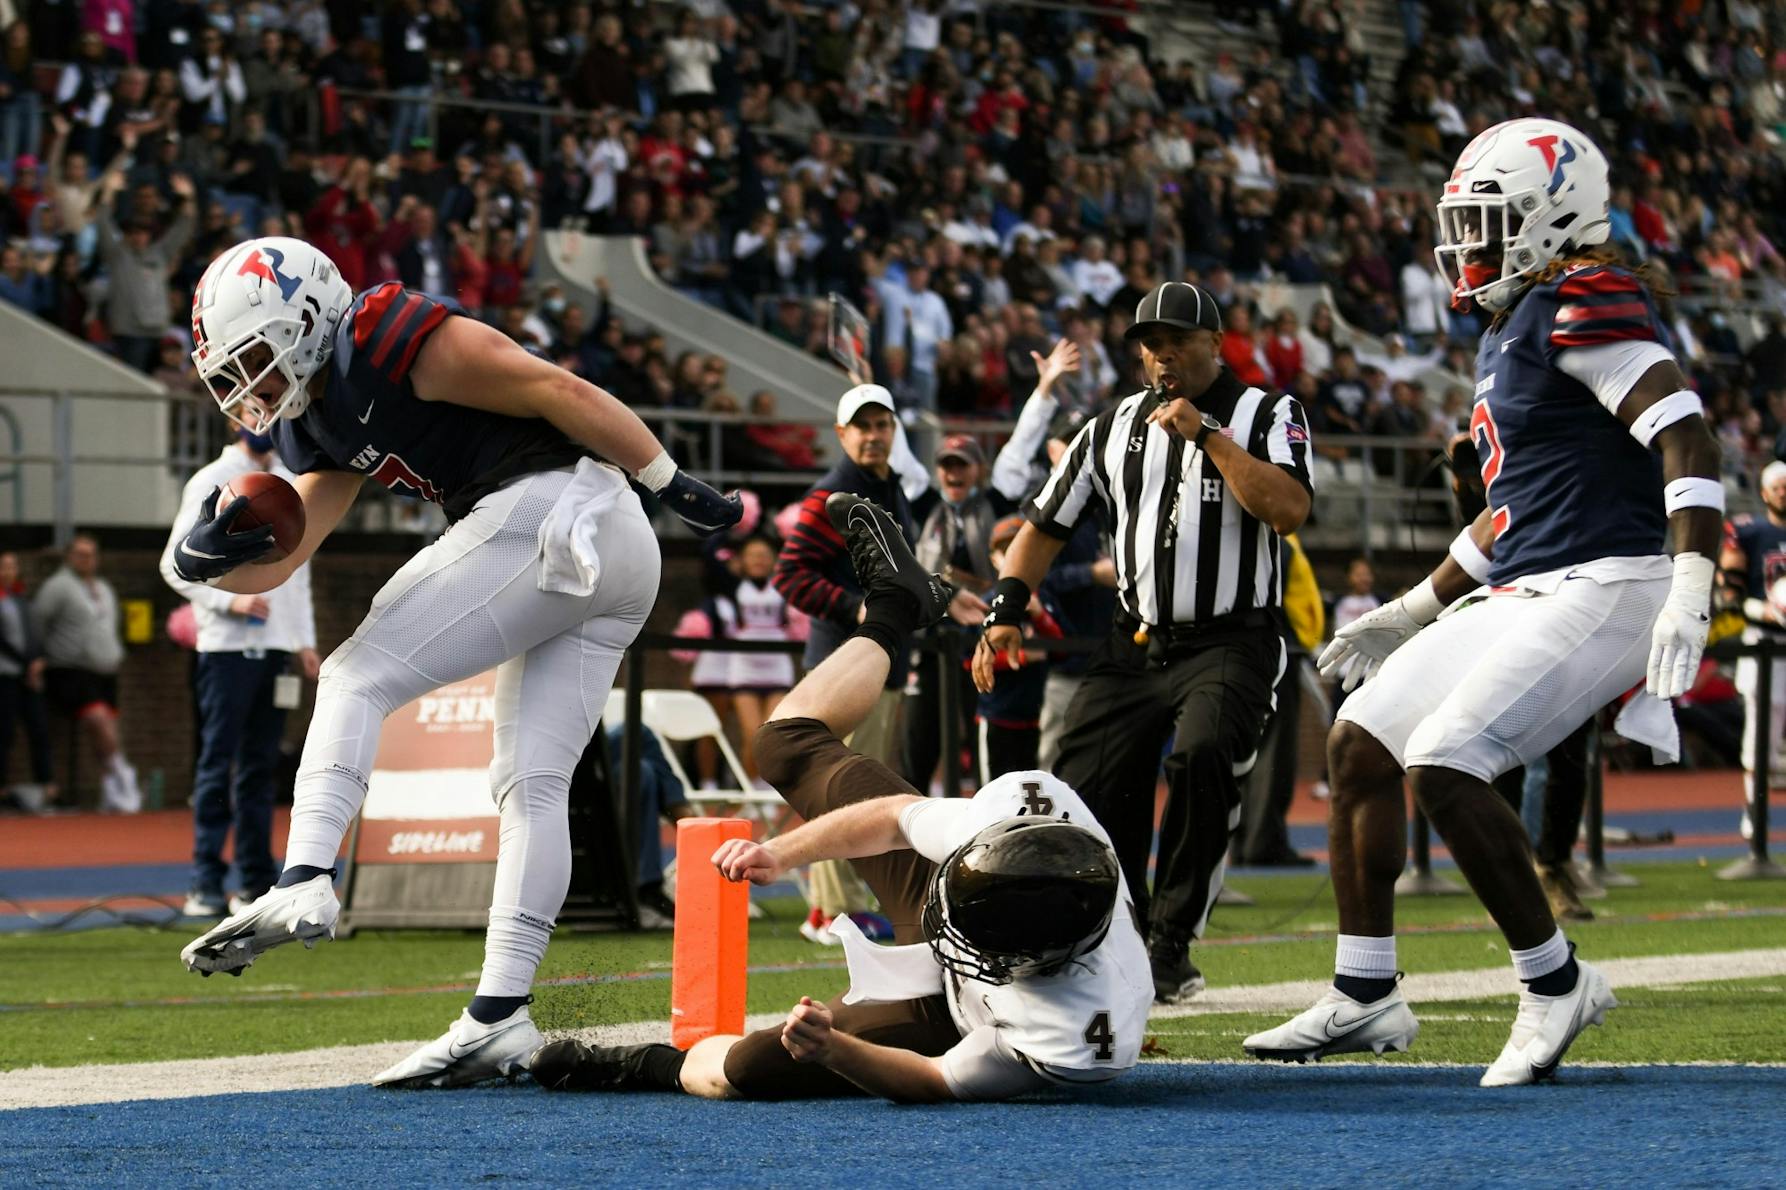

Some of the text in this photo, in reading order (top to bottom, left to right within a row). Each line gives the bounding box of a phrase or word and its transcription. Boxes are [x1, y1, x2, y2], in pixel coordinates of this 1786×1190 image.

[1128, 436, 1143, 452] S
[1470, 397, 1512, 542] 2
[1202, 478, 1222, 502] H
[415, 697, 496, 723] PENN
[1020, 781, 1054, 816] 4
[1083, 1010, 1117, 1063] 4
